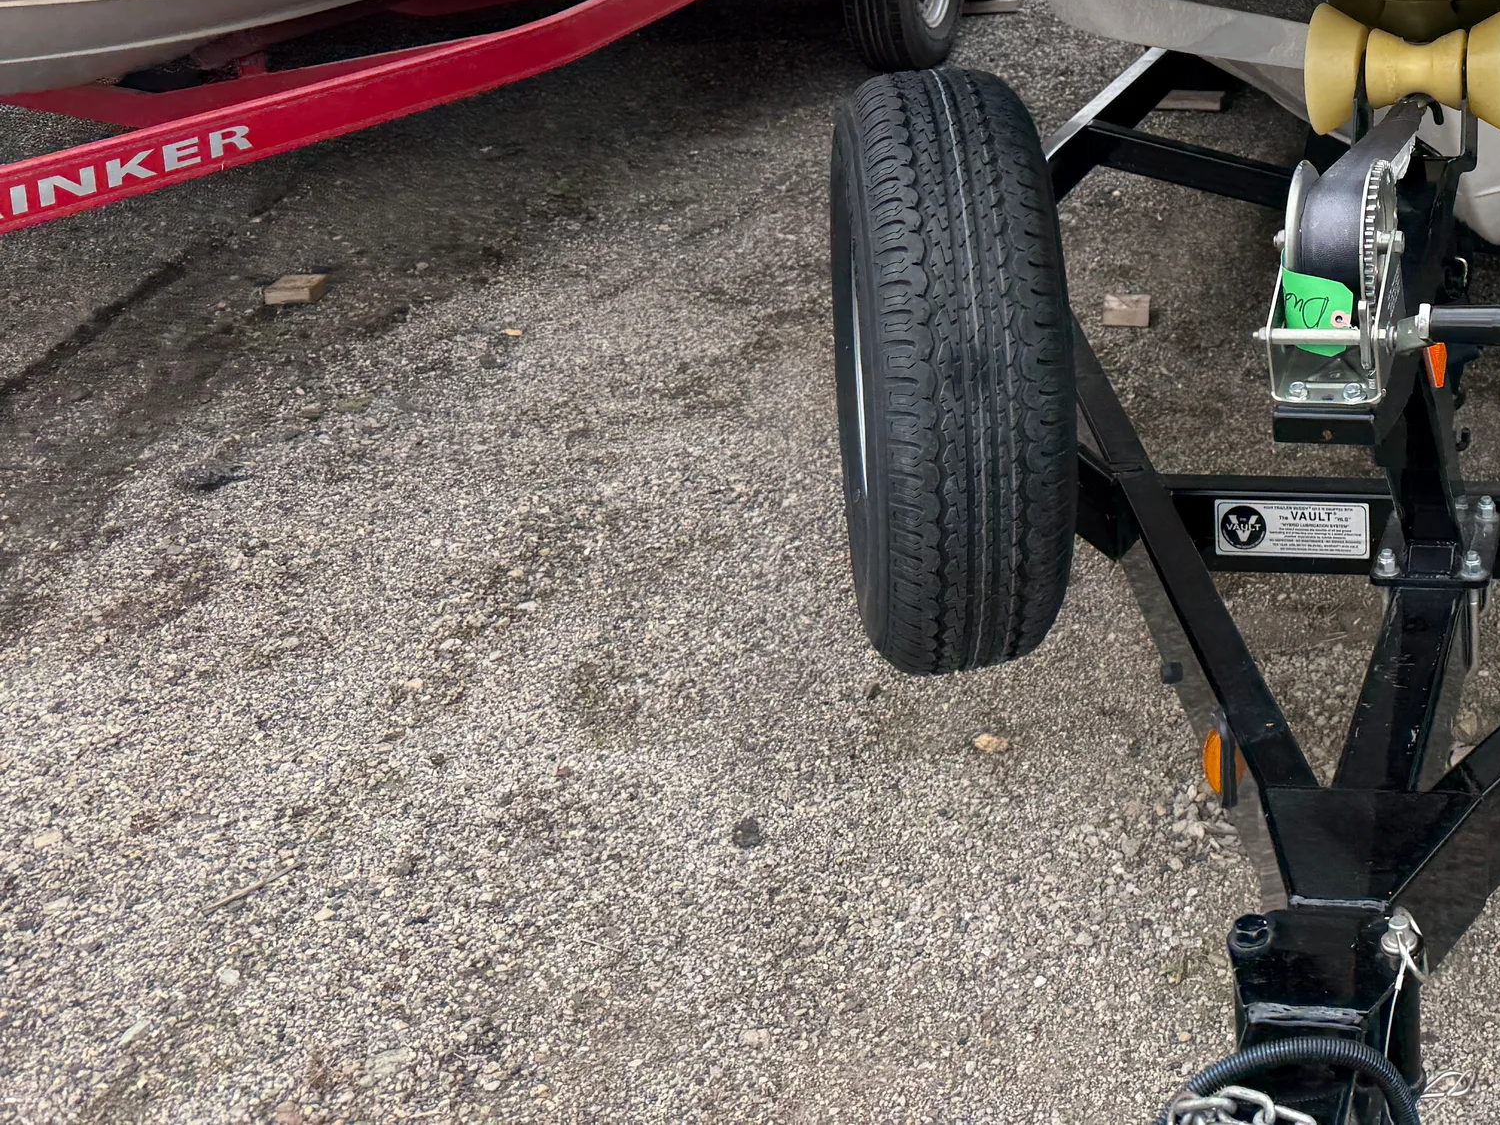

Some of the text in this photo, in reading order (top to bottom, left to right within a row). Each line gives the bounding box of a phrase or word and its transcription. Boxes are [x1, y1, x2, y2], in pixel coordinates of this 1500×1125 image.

[0, 125, 253, 220] INKER
[1290, 510, 1333, 522] VAULT
[1226, 523, 1262, 531] VAULT
